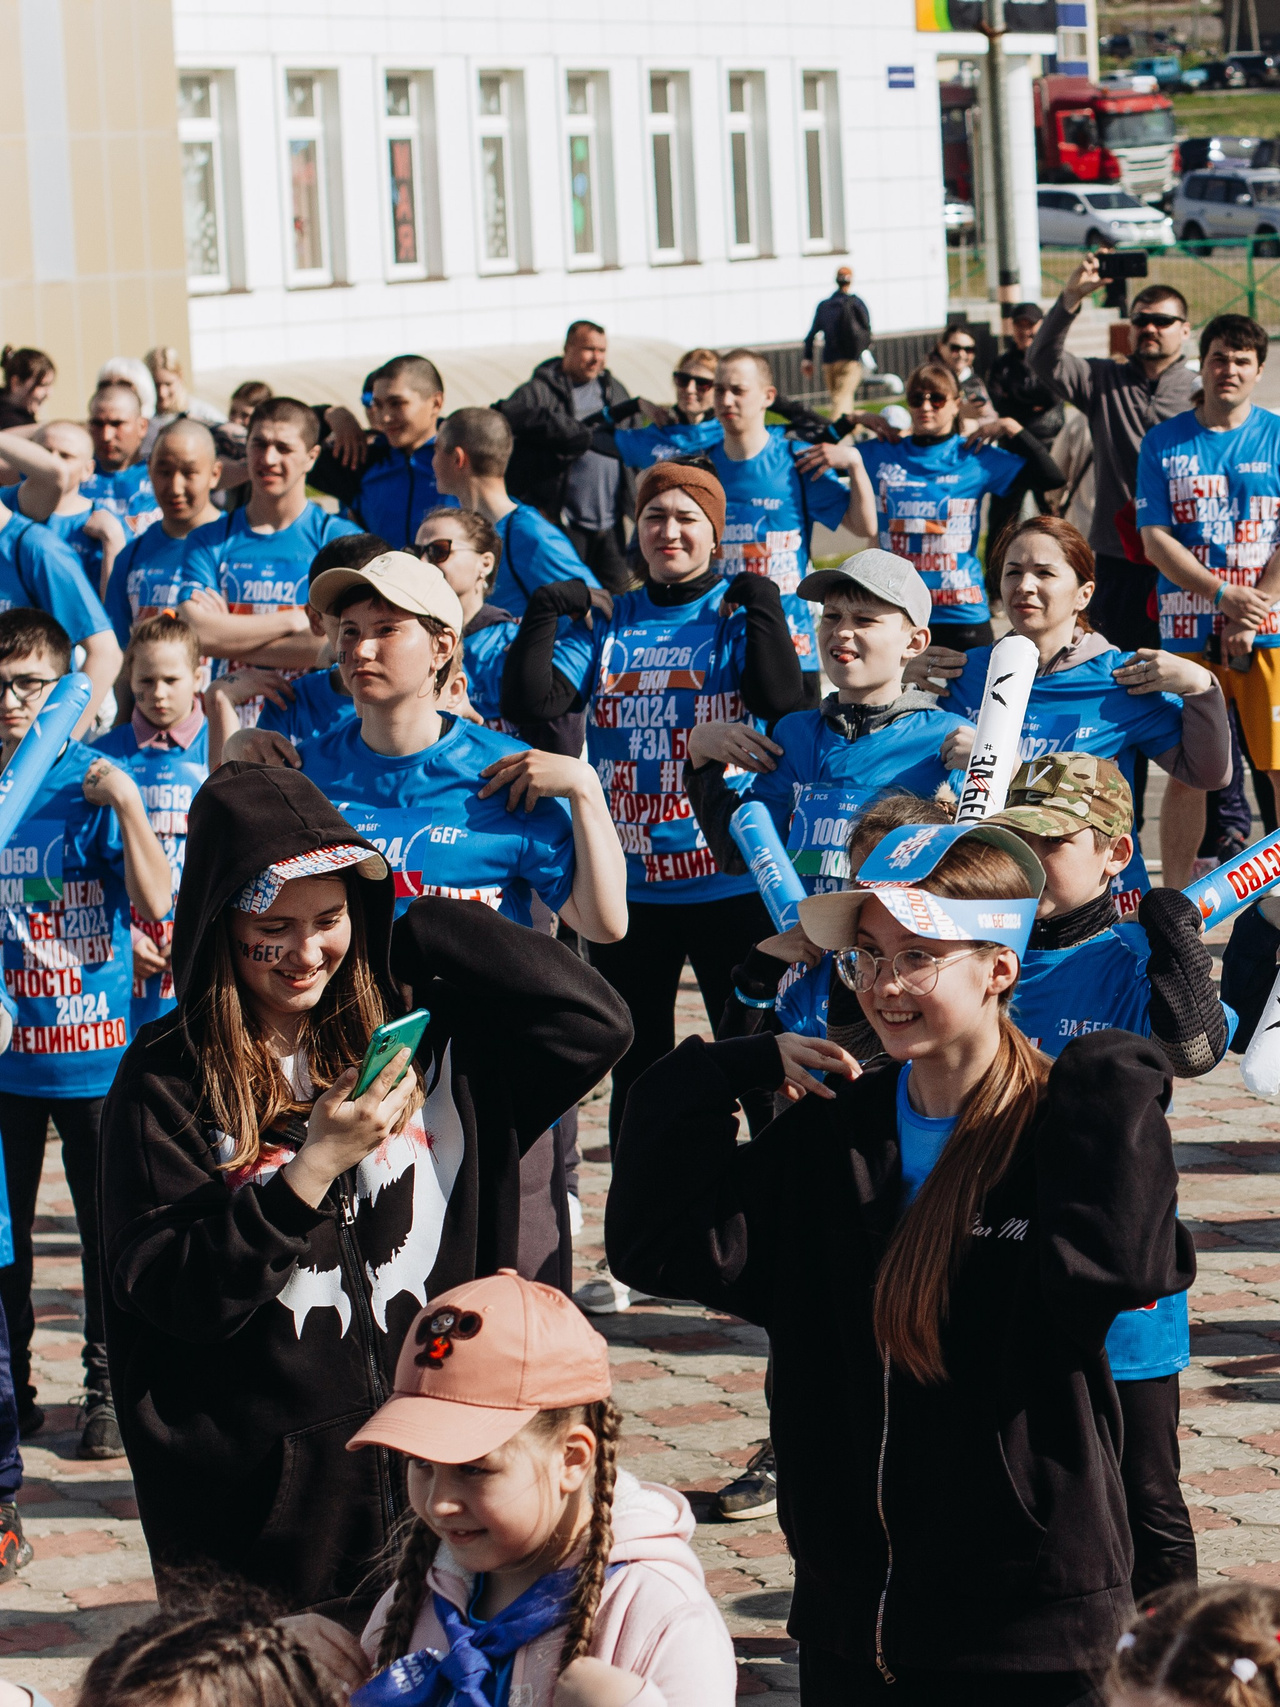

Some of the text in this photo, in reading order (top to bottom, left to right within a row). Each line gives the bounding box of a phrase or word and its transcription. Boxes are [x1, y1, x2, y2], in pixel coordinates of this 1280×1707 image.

[242, 580, 295, 603] 20042
[630, 646, 693, 669] 20026
[638, 670, 671, 690] 5КМ
[628, 728, 691, 761] #ЗАБ
[609, 790, 696, 824] #ГОРДОС
[813, 793, 829, 801] ПСБ
[811, 817, 851, 846] 100
[642, 847, 720, 883] #ЕДИН
[905, 889, 931, 932] ОСТЬ
[56, 991, 110, 1025] 2024
[11, 1017, 127, 1054] #ЕДИНСТВО
